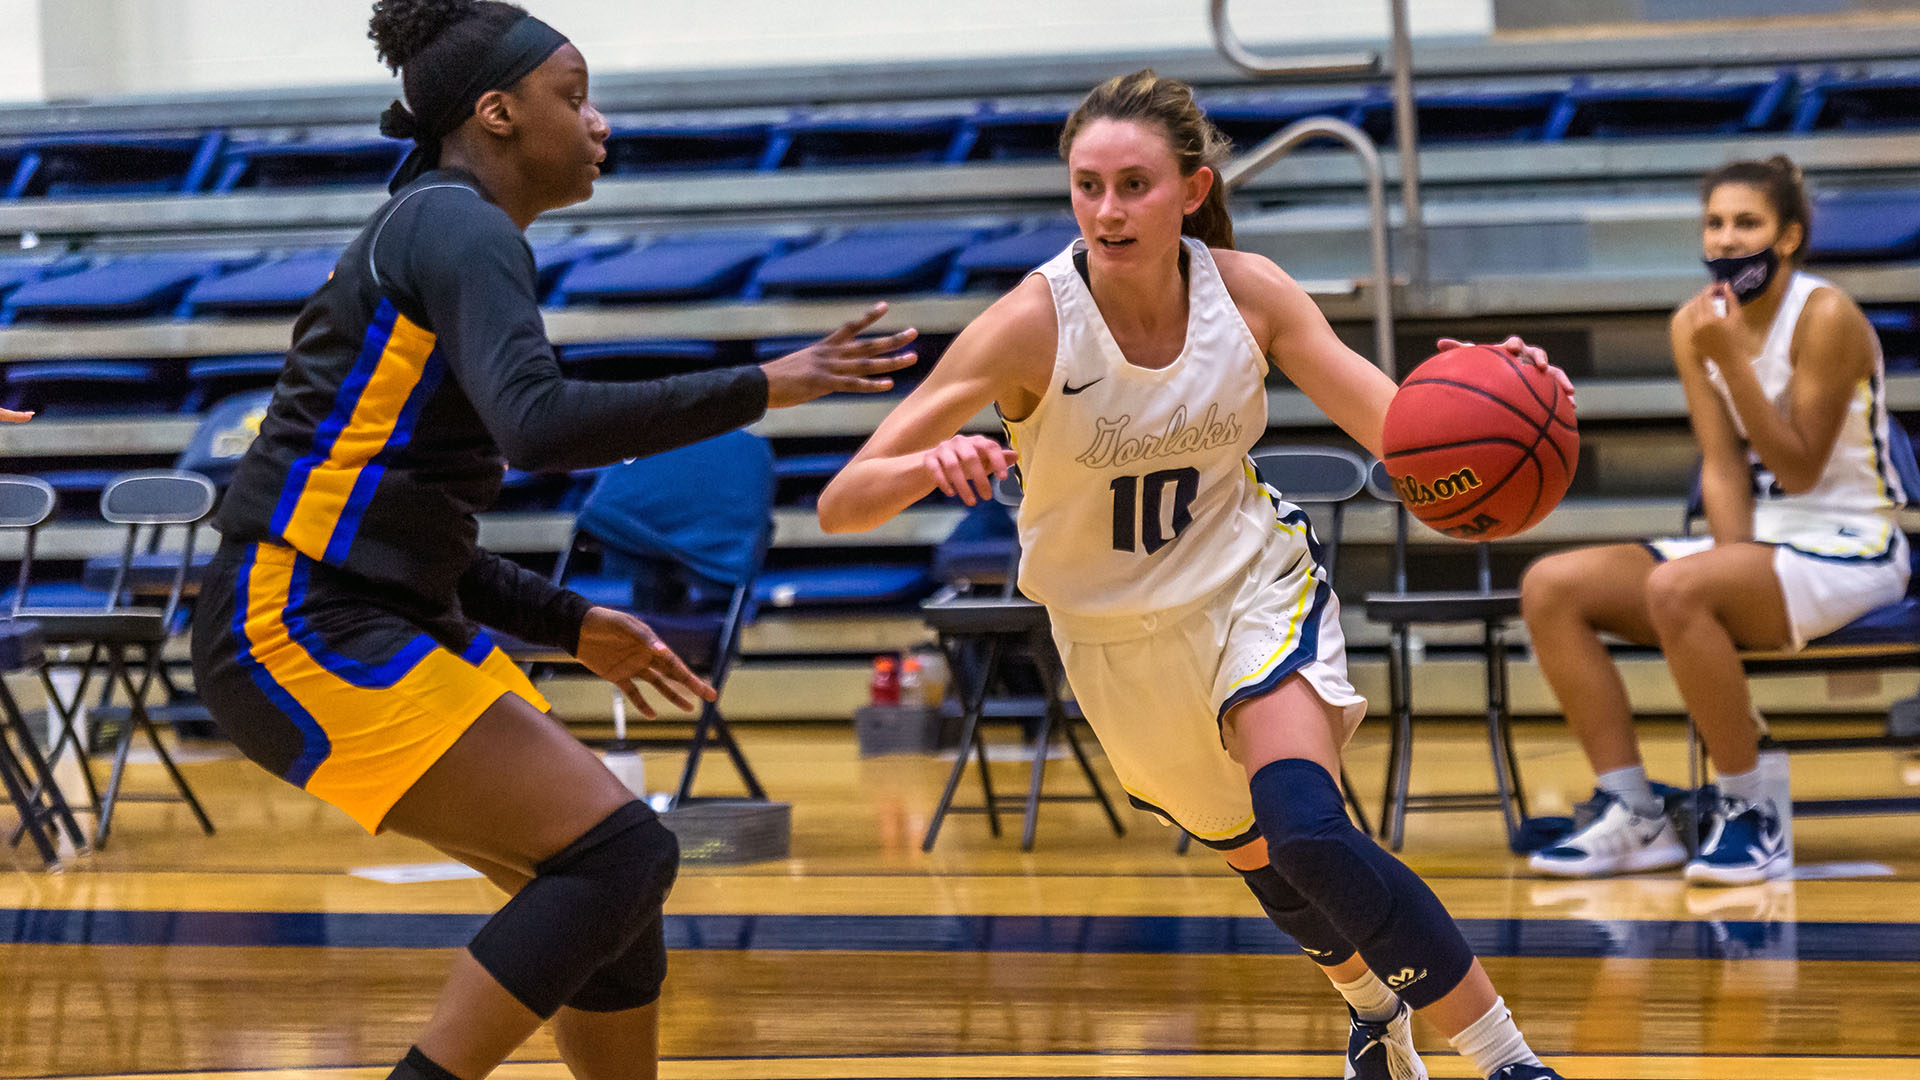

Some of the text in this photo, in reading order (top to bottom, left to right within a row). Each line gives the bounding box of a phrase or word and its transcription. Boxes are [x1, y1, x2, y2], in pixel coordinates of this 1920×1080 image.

[1075, 402, 1242, 469] Gorloks
[1109, 466, 1200, 556] 10
[1391, 466, 1483, 506] ilson
